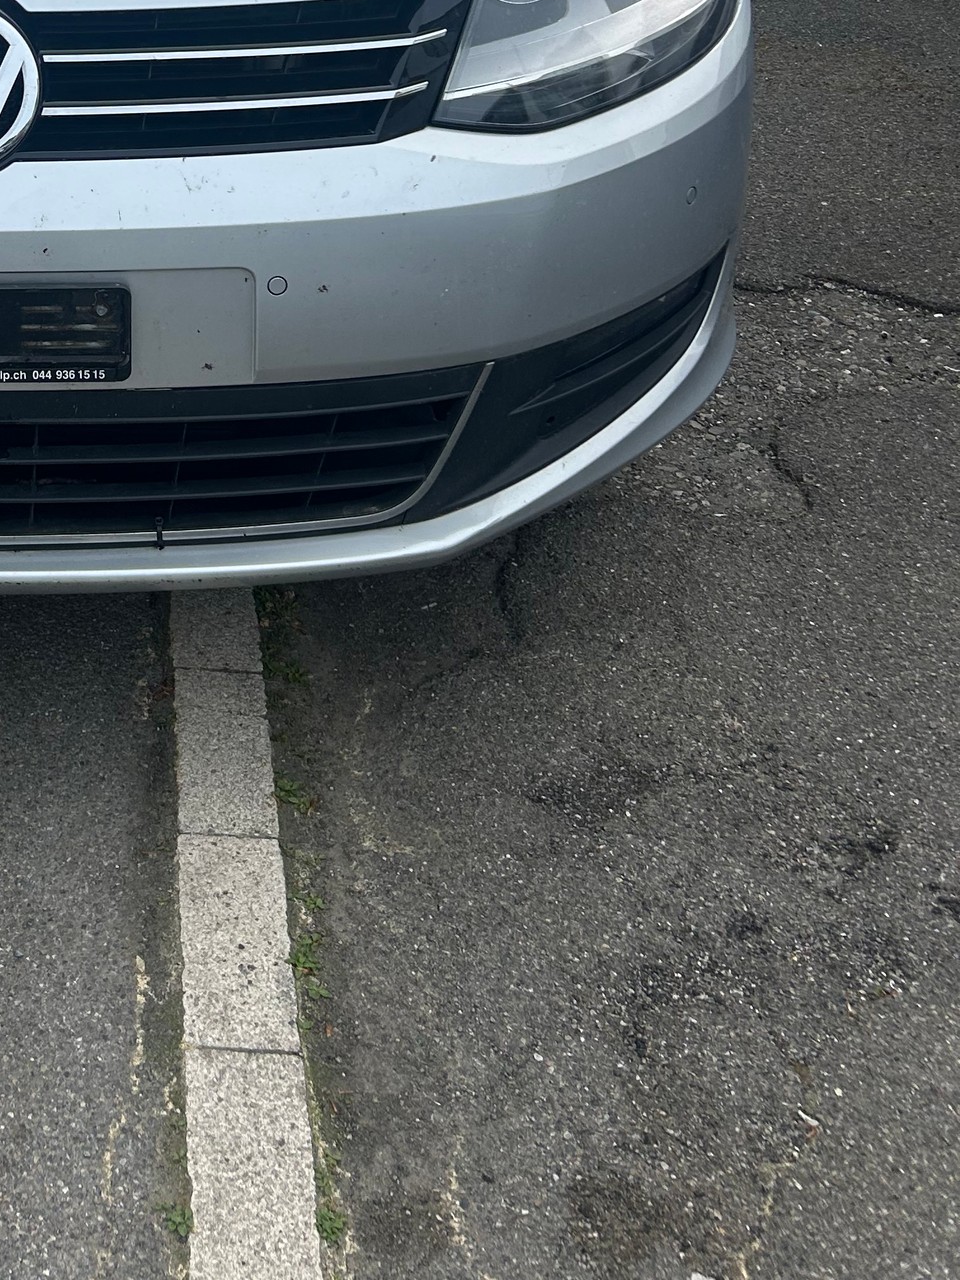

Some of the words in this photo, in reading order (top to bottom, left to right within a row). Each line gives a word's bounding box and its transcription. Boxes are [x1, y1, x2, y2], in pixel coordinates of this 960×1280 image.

[32, 369, 52, 380] 044
[55, 369, 75, 380] 936
[77, 369, 91, 380] 15
[92, 369, 106, 380] 15
